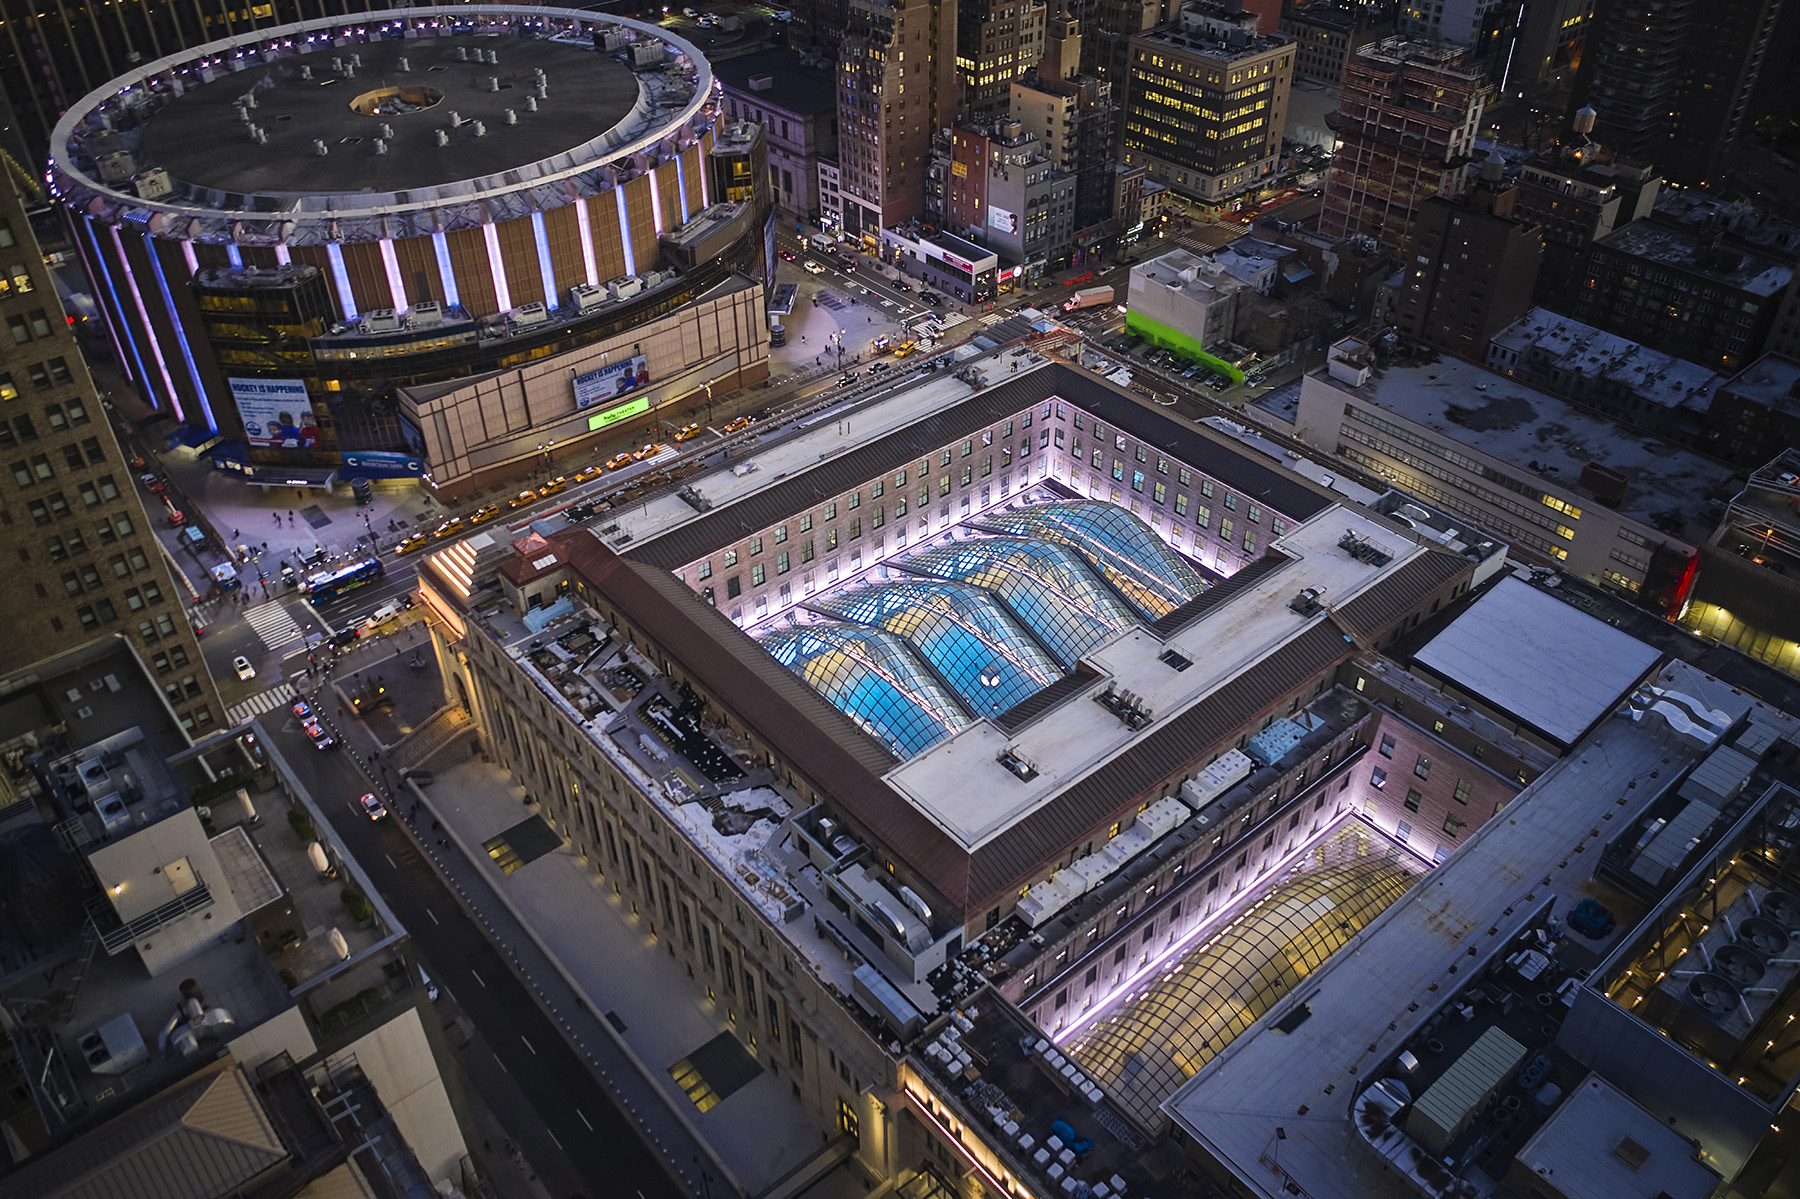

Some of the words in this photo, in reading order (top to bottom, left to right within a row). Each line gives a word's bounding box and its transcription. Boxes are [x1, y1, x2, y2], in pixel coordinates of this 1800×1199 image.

[577, 371, 598, 385] HOCKEY
[604, 359, 633, 375] HAPPENING
[231, 383, 258, 393] HOCKEY
[258, 384, 266, 393] IS
[266, 385, 305, 394] HAPPENING
